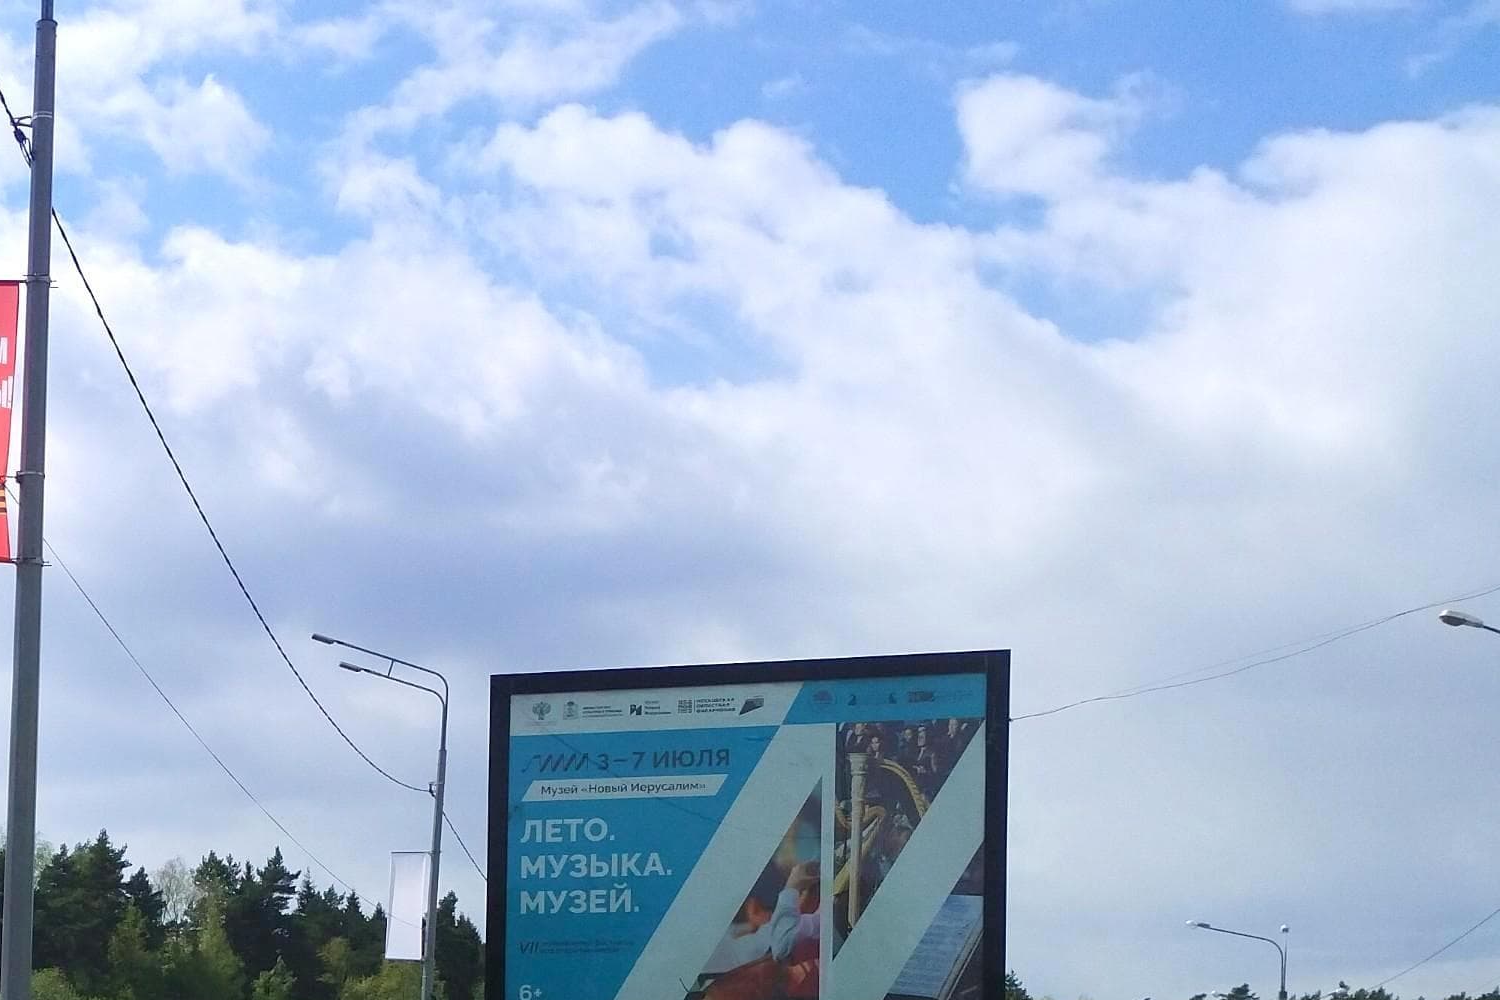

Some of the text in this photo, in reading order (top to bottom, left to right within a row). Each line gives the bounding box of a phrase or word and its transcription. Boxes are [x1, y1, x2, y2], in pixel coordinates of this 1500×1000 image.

[653, 748, 731, 769] ИЮЛЯ
[540, 782, 707, 796] Музей «Новый Иерусалим»
[520, 817, 616, 843] ЛЕТО.
[520, 852, 673, 879] МУЗЫКА.
[520, 882, 640, 914] МУЗЕЙ.
